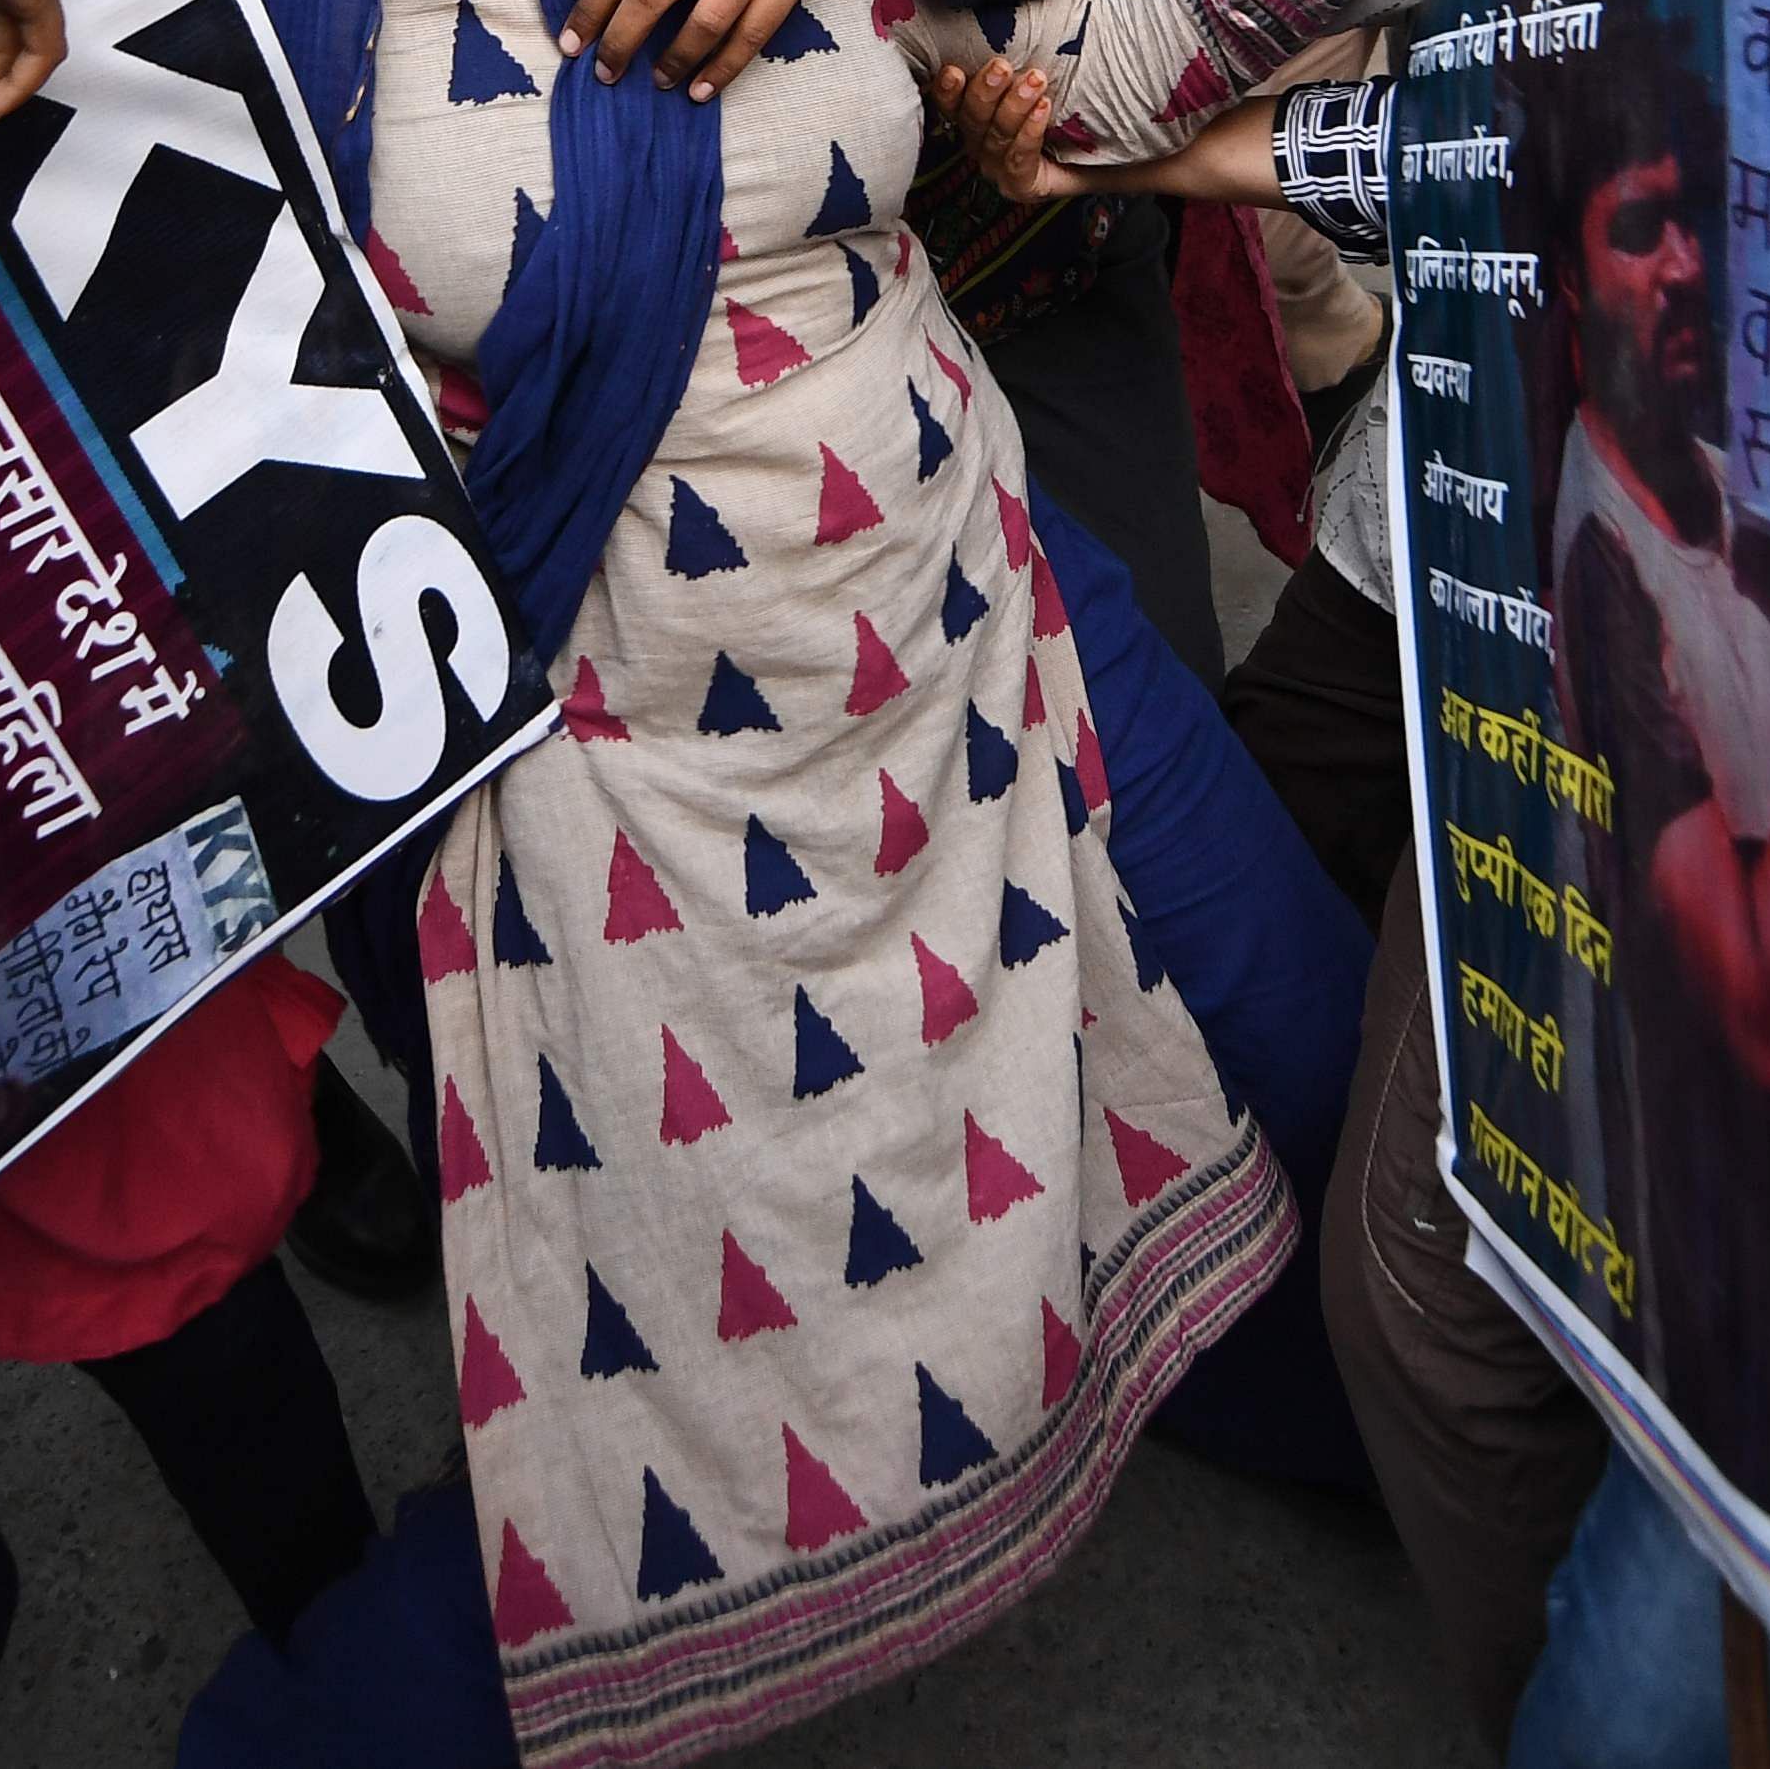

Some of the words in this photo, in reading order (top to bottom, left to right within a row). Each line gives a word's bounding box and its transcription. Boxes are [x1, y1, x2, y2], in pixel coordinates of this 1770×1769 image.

[1401, 142, 1424, 182] का
[1425, 139, 1463, 182] गला
[1407, 354, 1473, 405] व्यवस्था
[1454, 472, 1509, 525] न्याय
[1429, 567, 1454, 616] का
[1452, 579, 1499, 635] गला
[56, 553, 155, 680] देश
[120, 665, 204, 735] में
[1440, 685, 1475, 751] अब
[1476, 708, 1542, 786] कहीं
[127, 860, 191, 974] हाथरस
[1445, 818, 1521, 909] चुप्पी
[1519, 863, 1558, 939] एक
[1562, 883, 1615, 989] दिन
[74, 935, 129, 1006] रेप
[1527, 1014, 1566, 1094] ही
